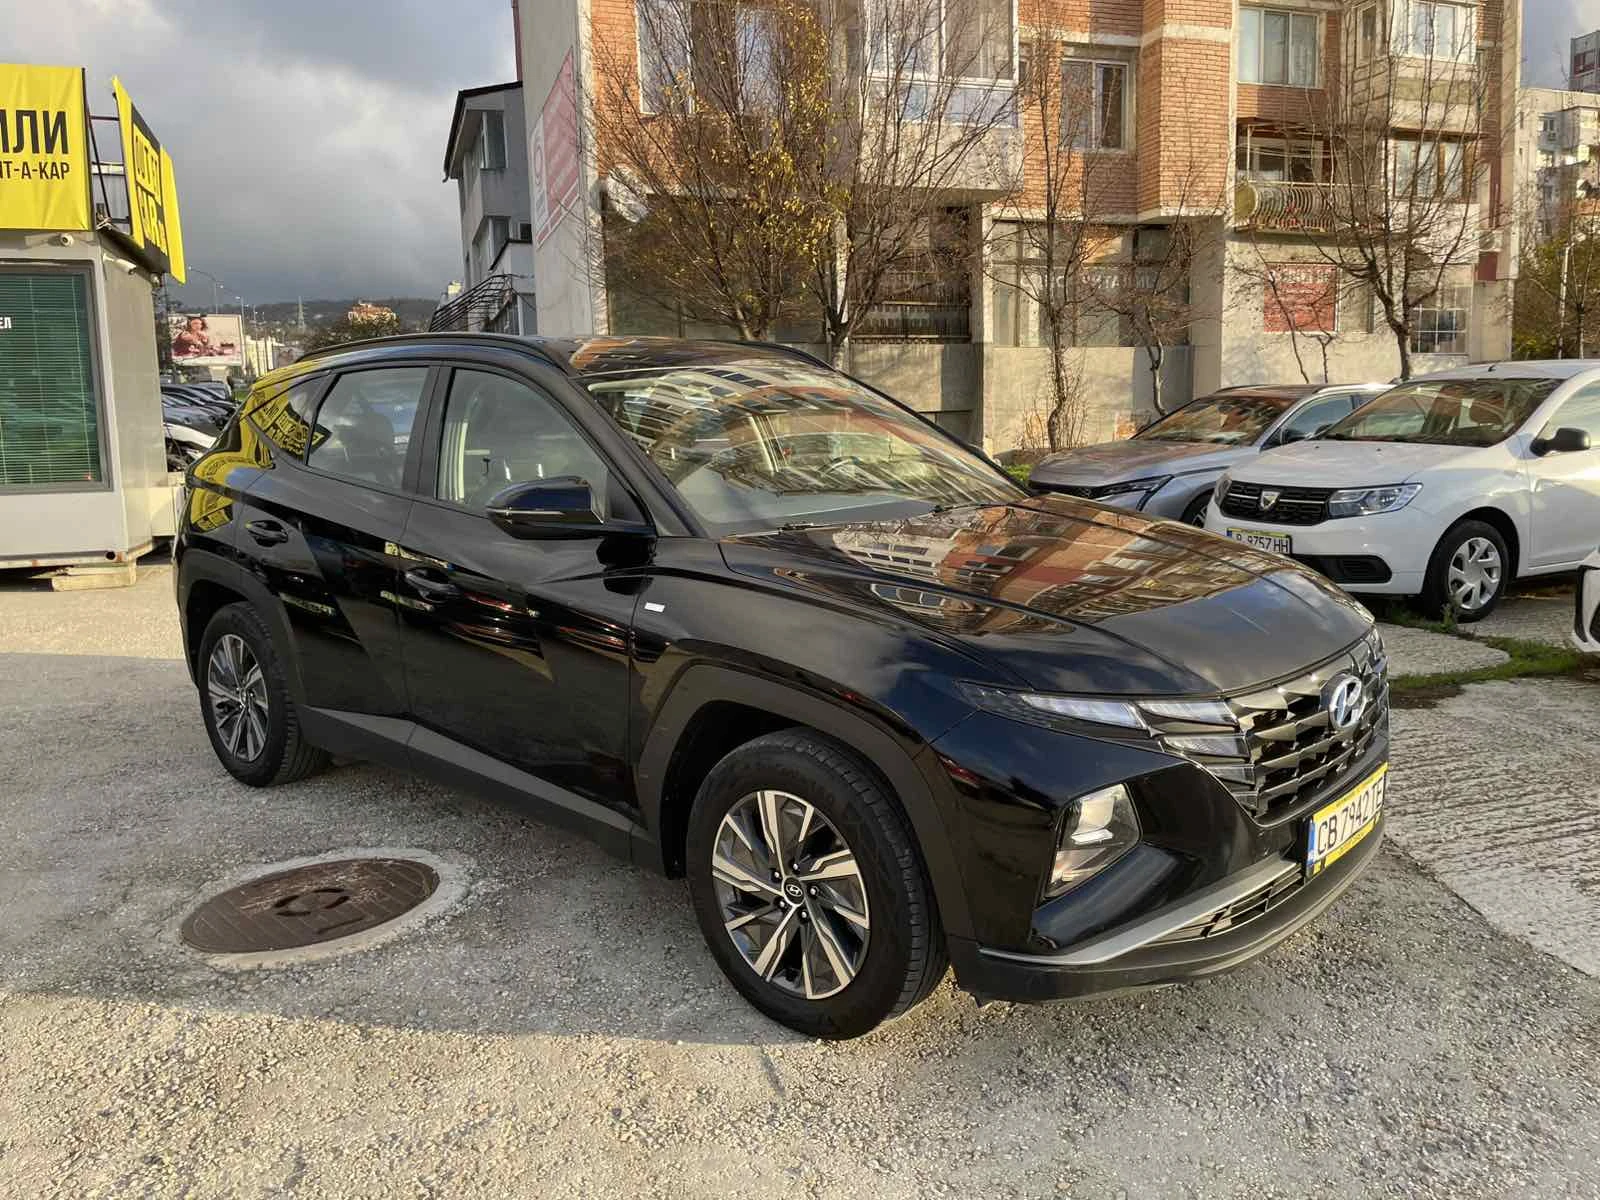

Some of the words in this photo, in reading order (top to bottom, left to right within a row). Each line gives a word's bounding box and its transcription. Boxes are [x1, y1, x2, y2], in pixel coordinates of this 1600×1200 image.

[0, 160, 70, 180] Т-А-КАР
[1318, 815, 1338, 854] CB
[1341, 790, 1370, 841] 7942
